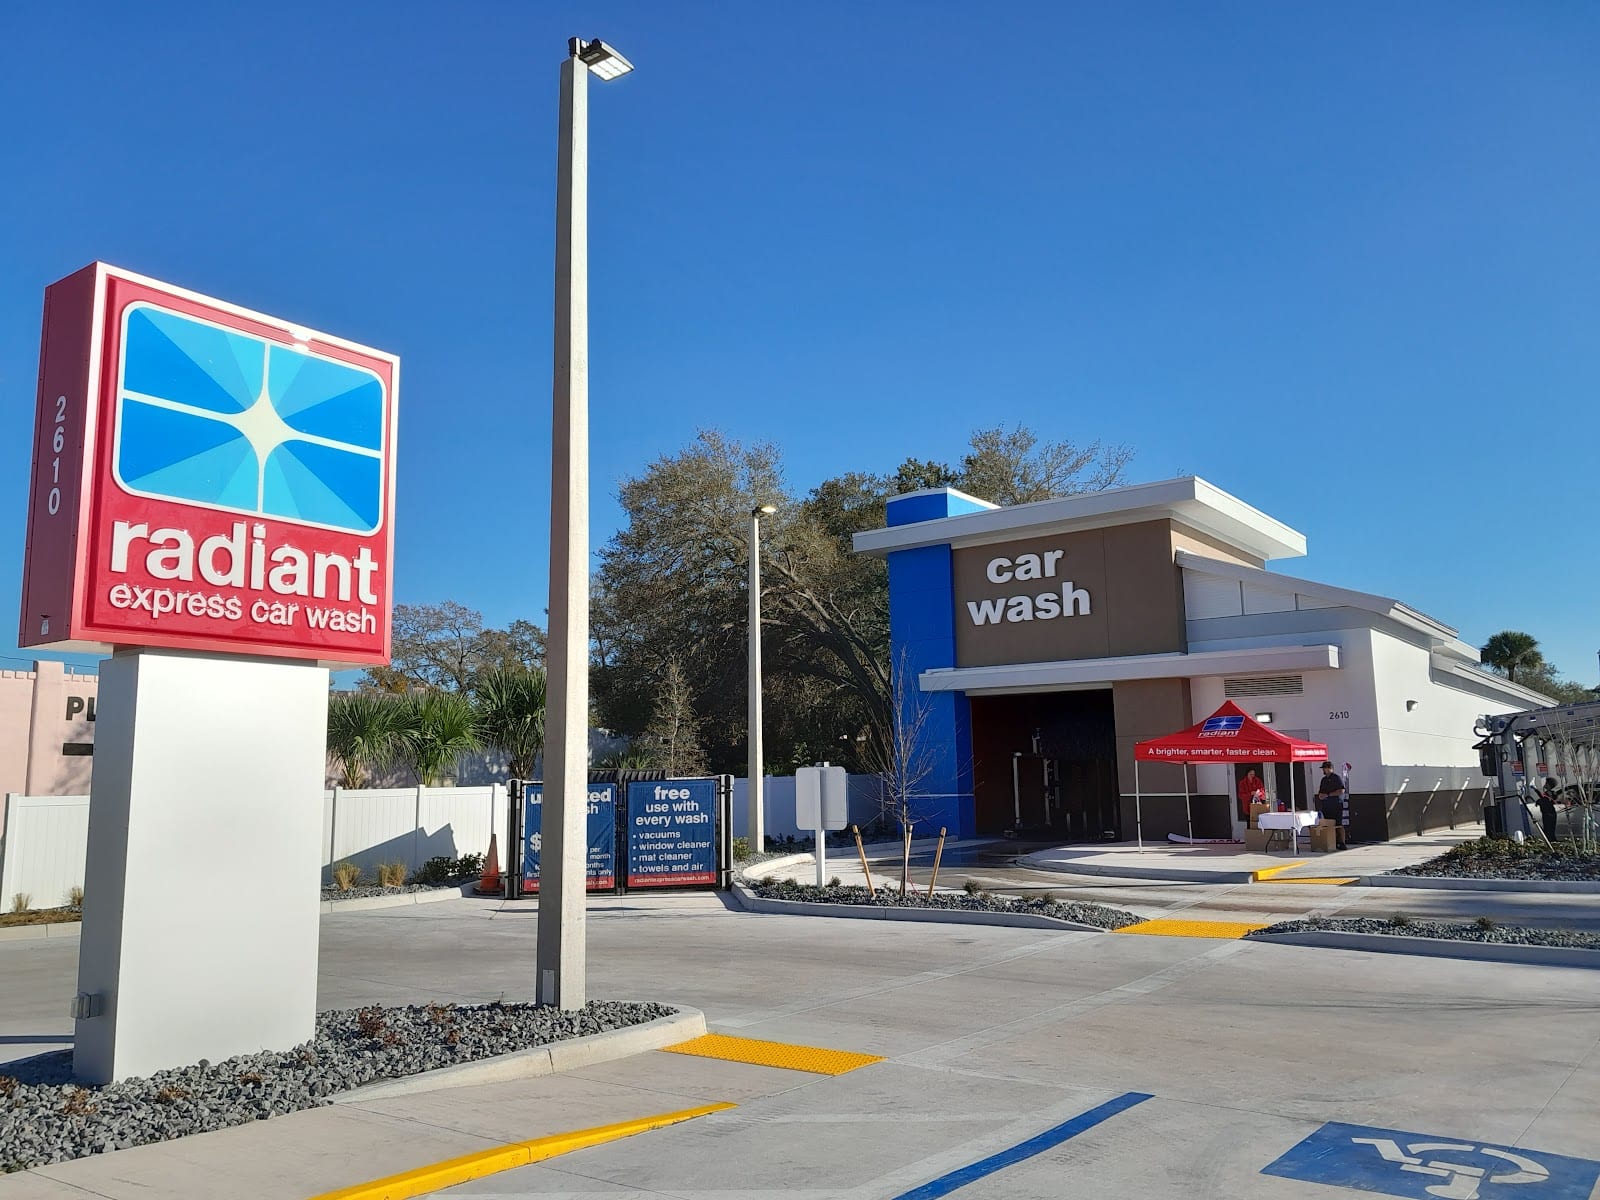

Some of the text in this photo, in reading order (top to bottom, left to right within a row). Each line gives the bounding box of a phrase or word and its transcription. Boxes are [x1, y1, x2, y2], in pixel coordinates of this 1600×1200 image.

[48, 395, 67, 516] 2610
[111, 520, 379, 605] radiant
[986, 549, 1065, 584] car
[109, 583, 376, 635] express car wash
[966, 581, 1092, 626] wash
[1329, 711, 1350, 720] 2610
[1198, 729, 1240, 737] radiant
[1156, 747, 1189, 757] brighter,
[1191, 747, 1224, 757] smarter,
[1226, 747, 1250, 756] faster
[1252, 747, 1278, 756] clean.
[654, 785, 691, 801] free
[645, 800, 699, 813] use with
[635, 812, 709, 828] every wash
[639, 831, 681, 840] vacuums
[590, 847, 601, 855] per
[639, 840, 711, 851] window cleaner
[639, 852, 693, 862] mat cleaner
[639, 861, 704, 873] towels and air
